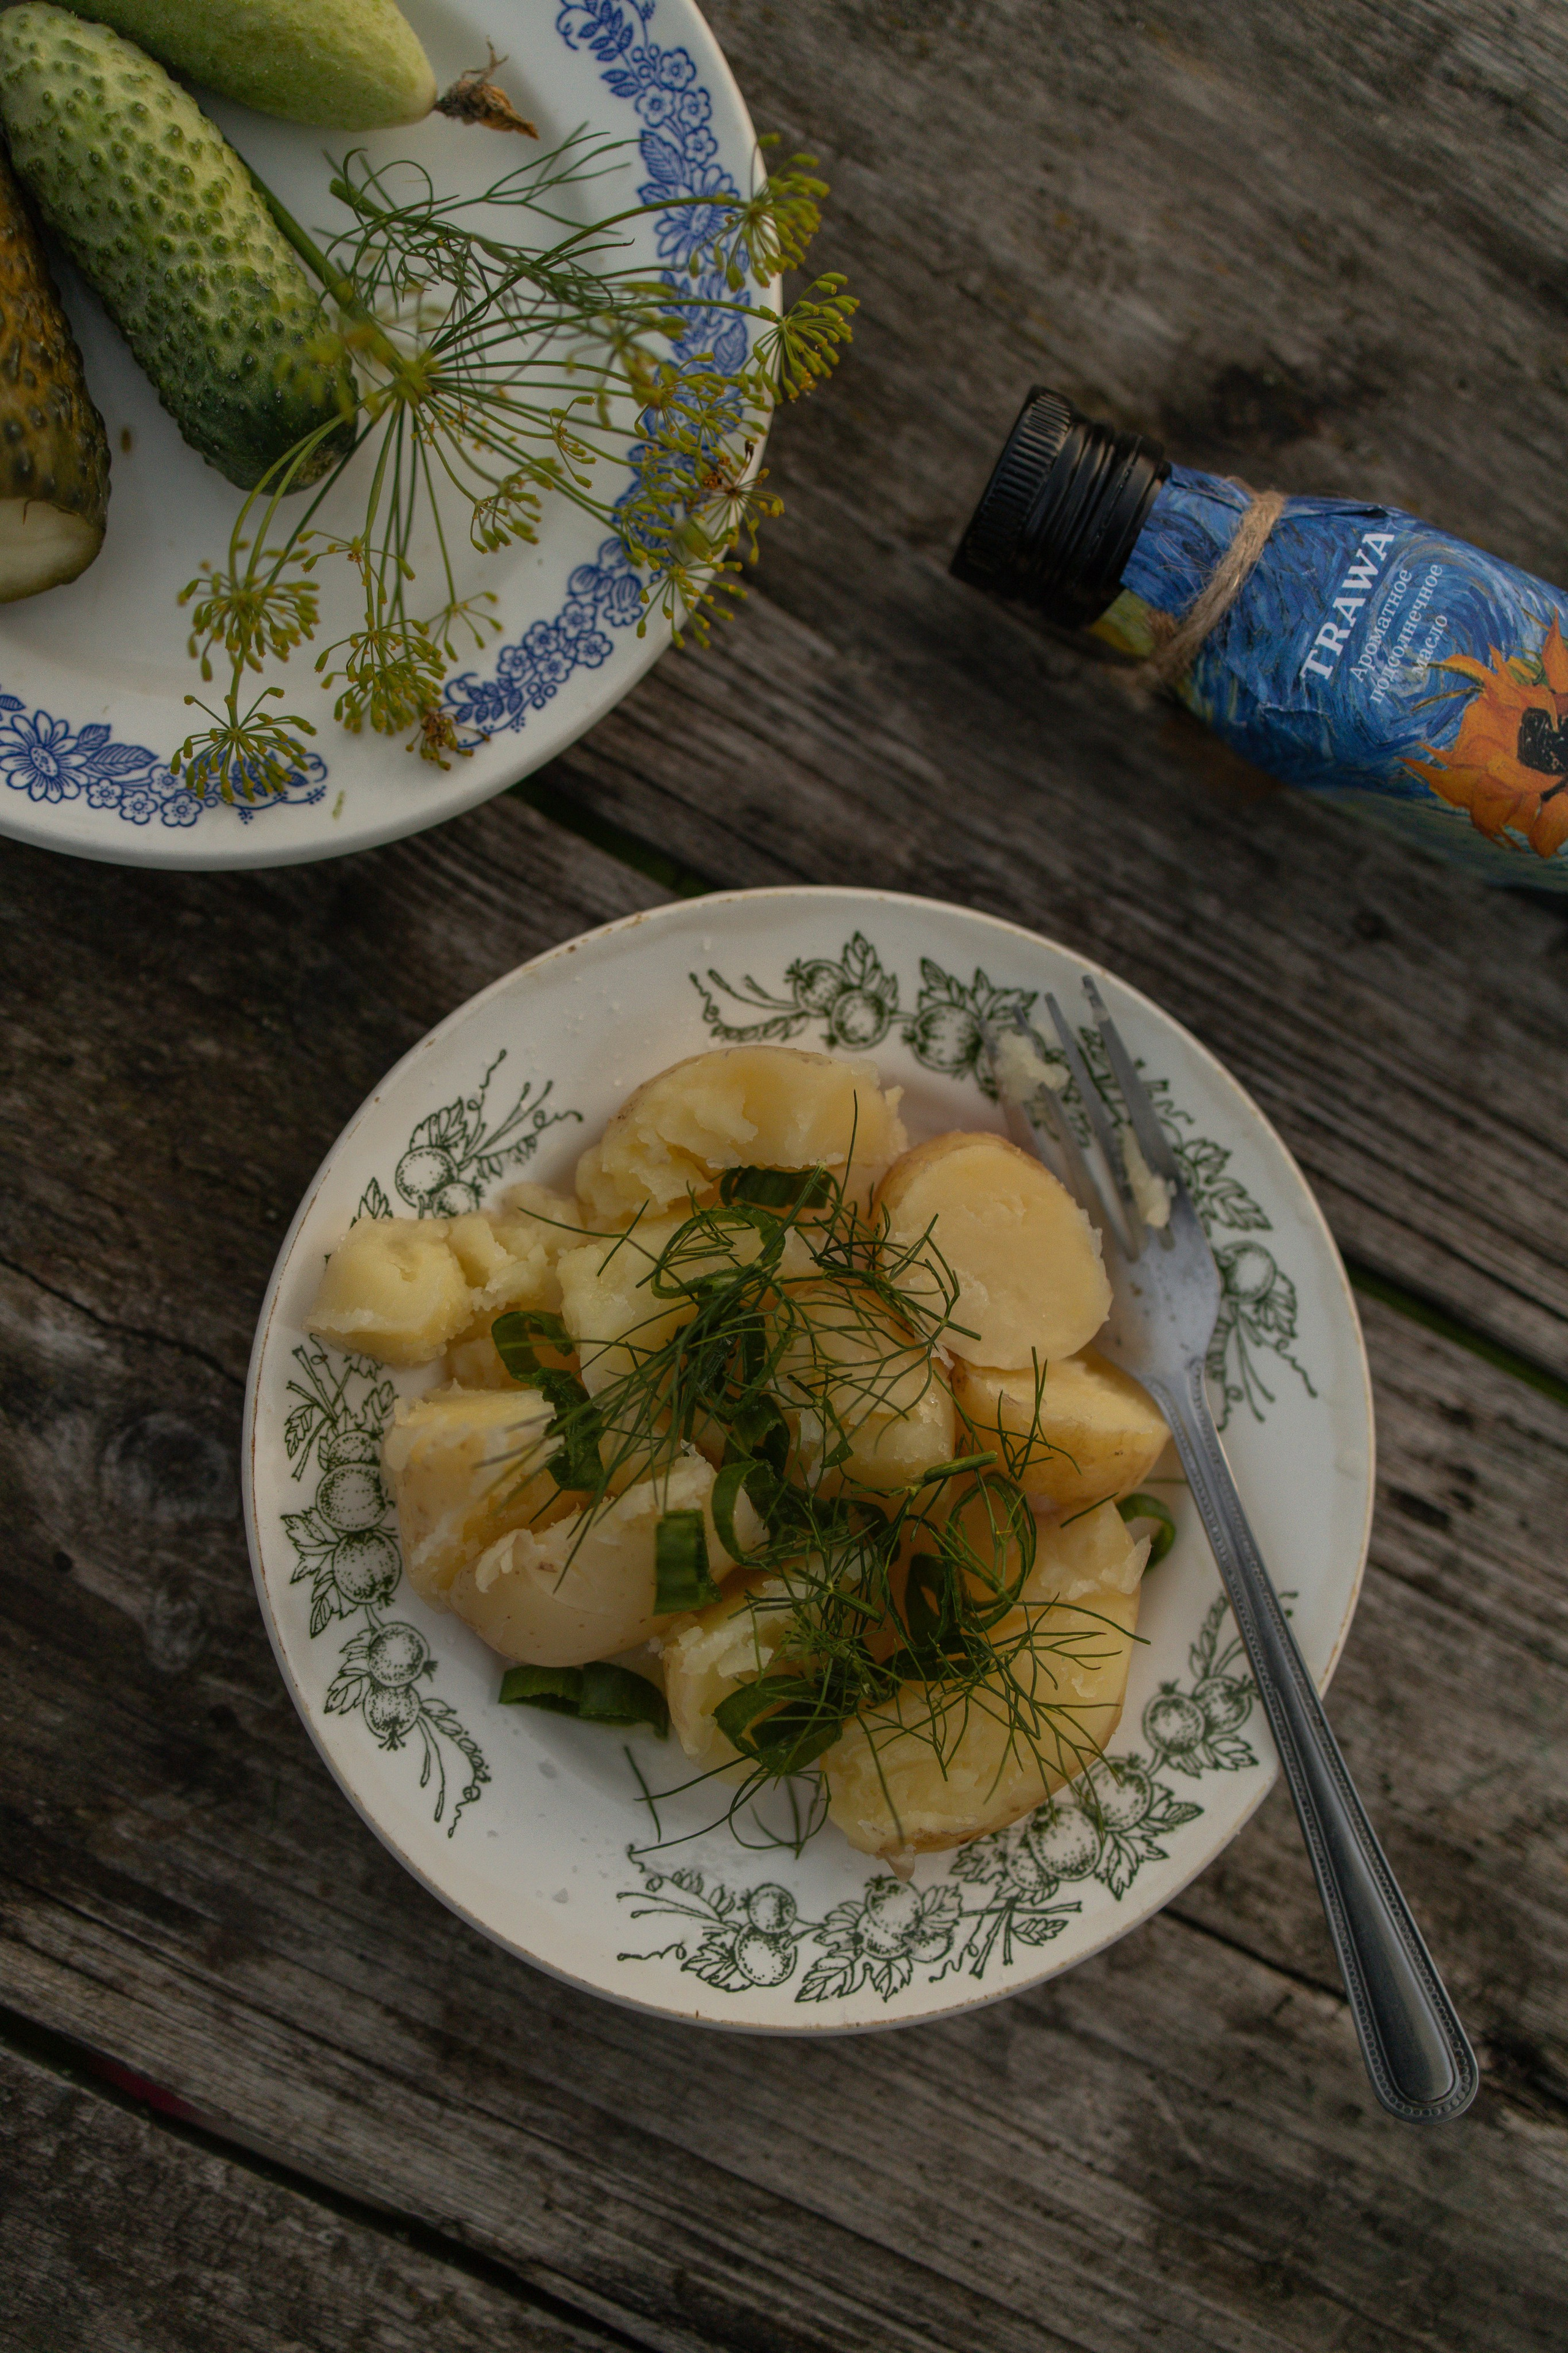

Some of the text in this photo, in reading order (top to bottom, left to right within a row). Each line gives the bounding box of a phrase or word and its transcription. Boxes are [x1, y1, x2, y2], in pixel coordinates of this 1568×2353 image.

[1299, 533, 1395, 680] TRAWA
[1349, 568, 1413, 683] Ароматное
[1370, 564, 1443, 705] подсолнечное
[1411, 614, 1448, 676] масло
